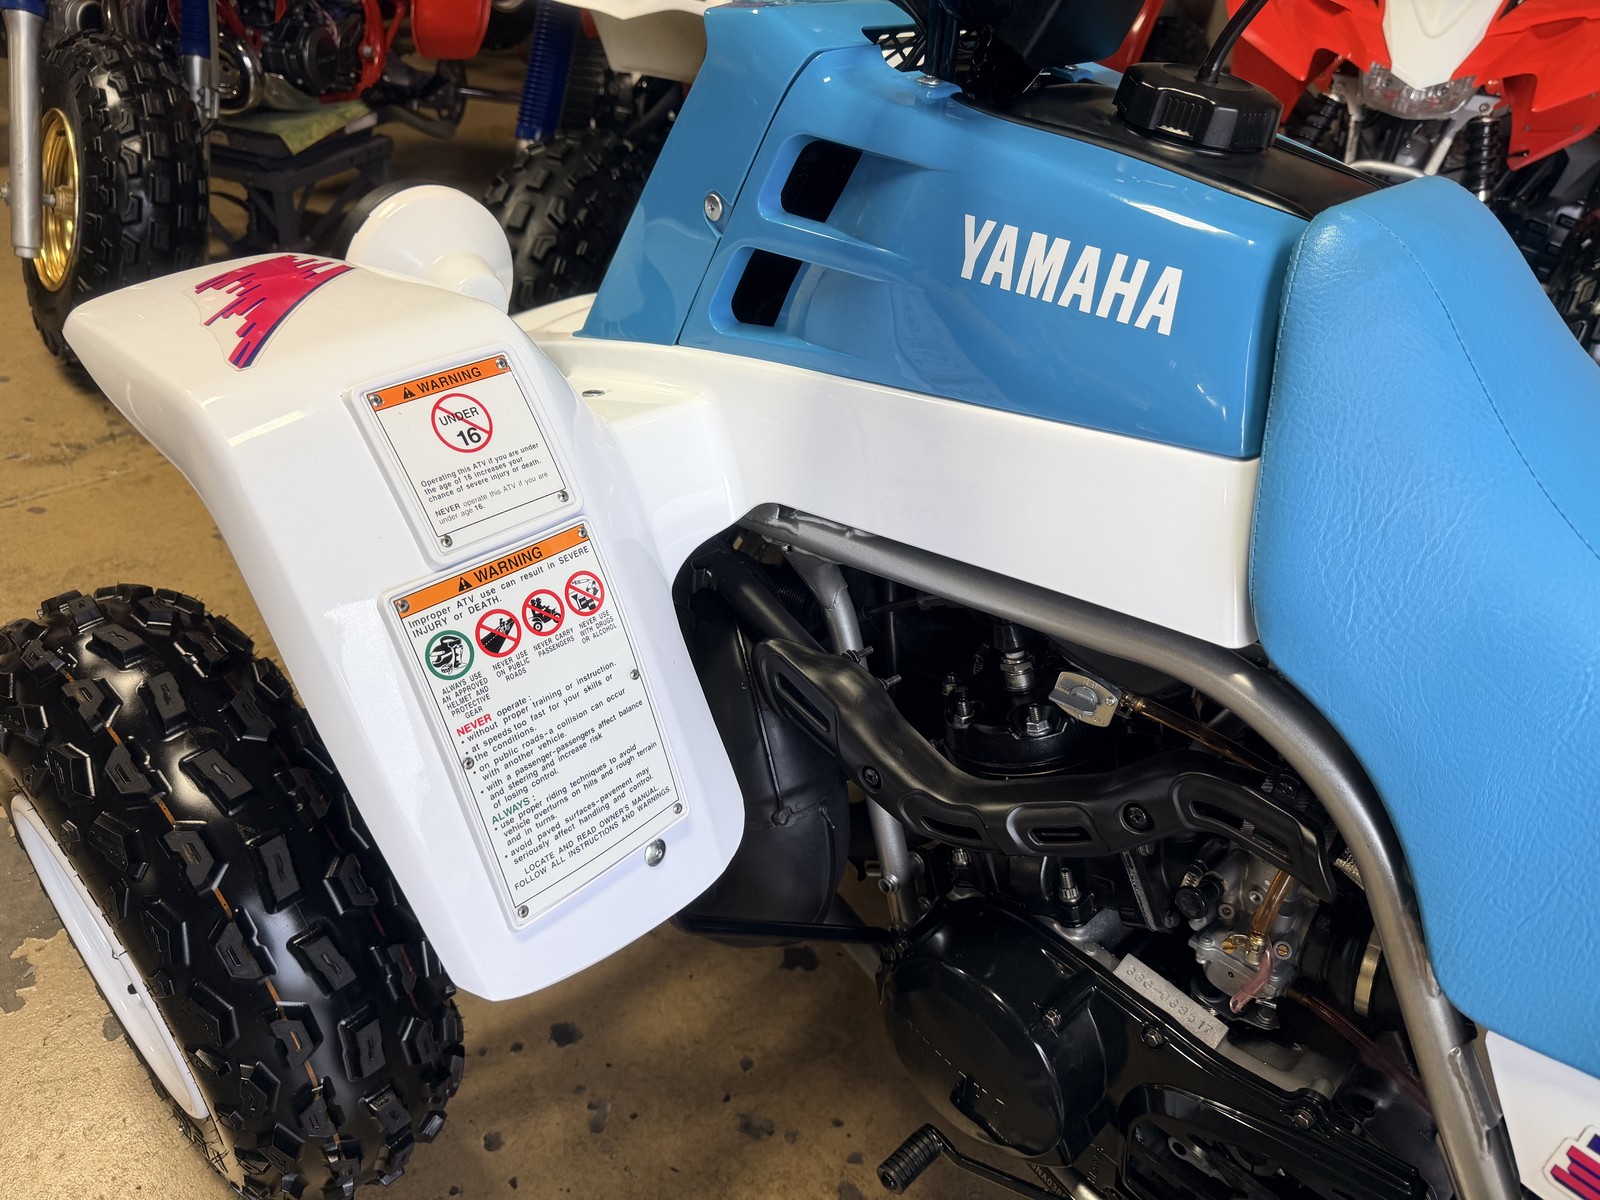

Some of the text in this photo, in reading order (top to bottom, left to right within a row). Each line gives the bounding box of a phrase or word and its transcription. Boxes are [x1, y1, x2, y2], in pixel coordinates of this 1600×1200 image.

[961, 214, 1183, 336] YAMAHA
[416, 367, 482, 393] WARNING
[439, 407, 479, 426] UNDER
[457, 425, 481, 446] 16
[421, 472, 457, 487] Operating
[457, 466, 471, 475] this
[473, 460, 486, 470] ATV
[494, 454, 507, 464] you
[520, 443, 538, 453] under
[424, 487, 436, 495] the
[439, 482, 452, 490] age
[454, 477, 462, 485] of
[473, 463, 507, 478] increases
[508, 457, 523, 467] your
[428, 490, 454, 502] chance
[466, 478, 489, 489] severe
[490, 470, 510, 480] injury
[521, 459, 541, 469] death.
[435, 503, 461, 517] NEVER
[463, 494, 488, 507] operate
[489, 489, 501, 497] this
[503, 482, 515, 492] ATV
[524, 477, 536, 486] you
[439, 503, 485, 524] under age 16.
[473, 547, 543, 583] WARNING
[408, 606, 450, 631] Improper
[457, 595, 474, 609] ATV
[480, 588, 496, 599] use
[501, 579, 516, 590] can
[520, 566, 544, 581] result
[558, 546, 589, 564] SEVERE
[412, 595, 502, 638] INJURY or DEATH.
[579, 610, 610, 629] NEVER USE
[580, 616, 614, 637] WITH DRUGS
[582, 623, 617, 644] OR ALCOHOL
[533, 627, 573, 651] NEVER CARRY
[538, 635, 575, 657] PASSENGERS
[492, 649, 528, 671] NEVER USE
[496, 657, 530, 677] ON PUBLIC
[505, 667, 527, 682] ROADS
[442, 671, 482, 695] ALWAYS USE
[442, 677, 488, 704] AN APPROVED
[447, 686, 489, 710] HELMET AND
[451, 693, 491, 717] PROTECTIVE
[465, 706, 483, 719] GEAR
[467, 662, 616, 741] without proper training or instruction.
[472, 744, 480, 753] at
[483, 728, 512, 746] speeds
[513, 720, 527, 730] too
[530, 709, 546, 721] fast
[549, 702, 559, 712] for
[563, 691, 579, 706] your
[583, 680, 602, 693] skills
[456, 714, 492, 737] NEVER
[479, 763, 490, 772] on
[493, 747, 518, 766] public
[557, 710, 588, 730] collision
[591, 701, 604, 711] can
[606, 688, 625, 702] occur
[474, 727, 537, 761] the conditions.
[482, 733, 567, 781] with another vehicle.
[486, 779, 503, 791] with
[598, 714, 616, 729] affect
[618, 700, 643, 717] balance
[490, 733, 603, 800] and steering and increase risk
[493, 768, 559, 809] of losing control.
[500, 817, 515, 829] use
[518, 800, 542, 820] proper
[546, 787, 567, 802] riding
[570, 763, 607, 788] techniques
[619, 743, 637, 758] avoid
[503, 742, 657, 837] vehicle overturns on hills and rough terrain
[511, 838, 532, 856] avoid
[537, 821, 561, 842] paved
[636, 767, 649, 779] may
[514, 774, 654, 864] seriously affect handling and control.
[507, 833, 521, 846] and
[535, 814, 557, 829] turns.
[514, 786, 671, 890] FOLLOW ALL INSTRUCTIONS AND WARNINGS.
[524, 786, 659, 874] LOCATE AND READ OWNER'S MANUAL.
